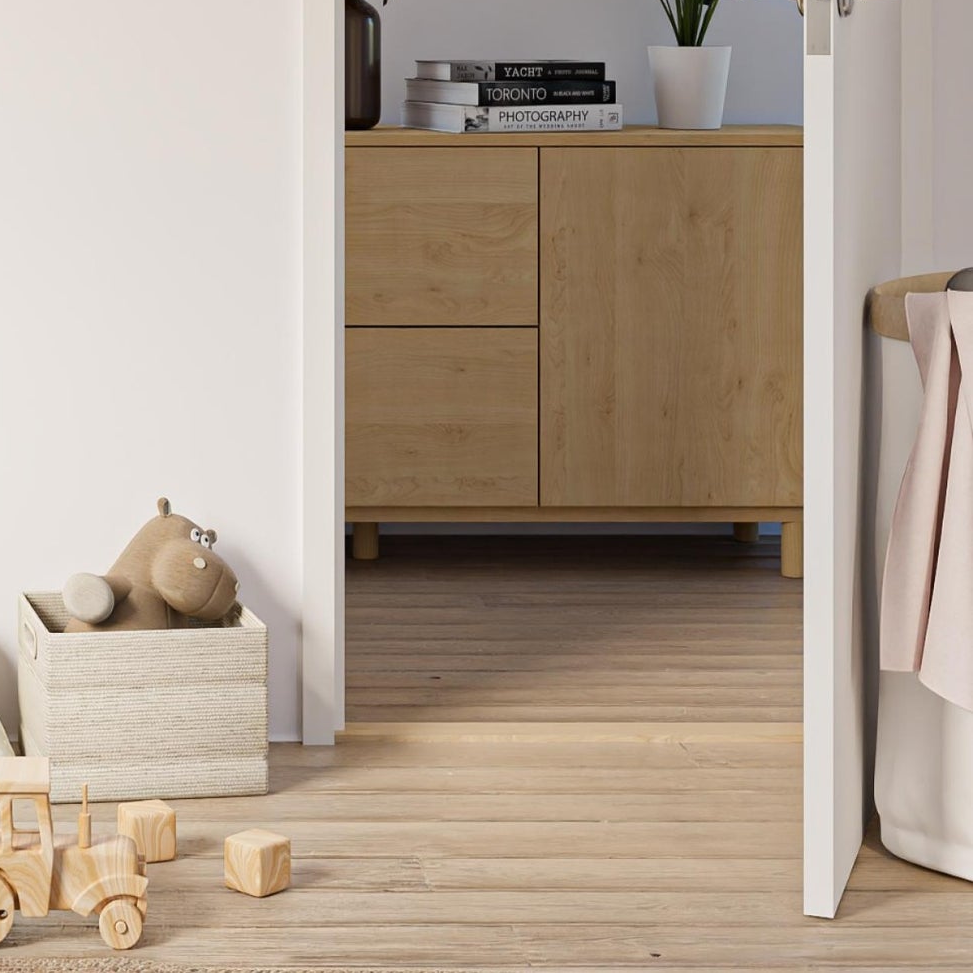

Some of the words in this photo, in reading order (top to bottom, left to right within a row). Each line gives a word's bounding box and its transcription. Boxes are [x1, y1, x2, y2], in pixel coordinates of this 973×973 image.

[504, 67, 544, 77] YACHT
[486, 87, 547, 101] TORONTO
[499, 110, 589, 122] PHOTOGRAPHY
